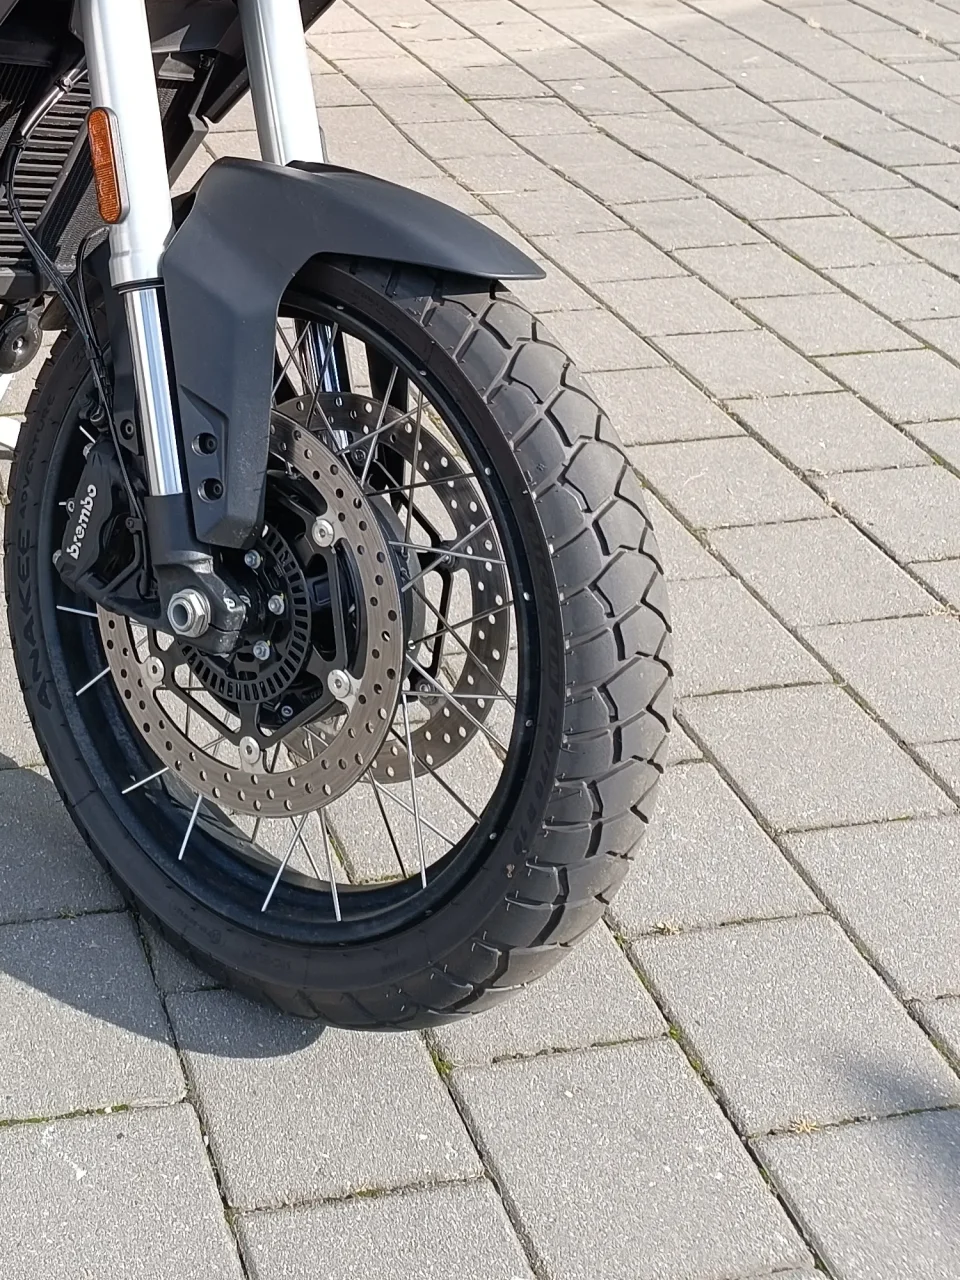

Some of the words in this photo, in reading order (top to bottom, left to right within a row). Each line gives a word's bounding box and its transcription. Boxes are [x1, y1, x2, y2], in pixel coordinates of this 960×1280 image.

[19, 392, 55, 519] ADVENTURE
[66, 484, 97, 560] brembo
[16, 527, 53, 710] ANAKEE
